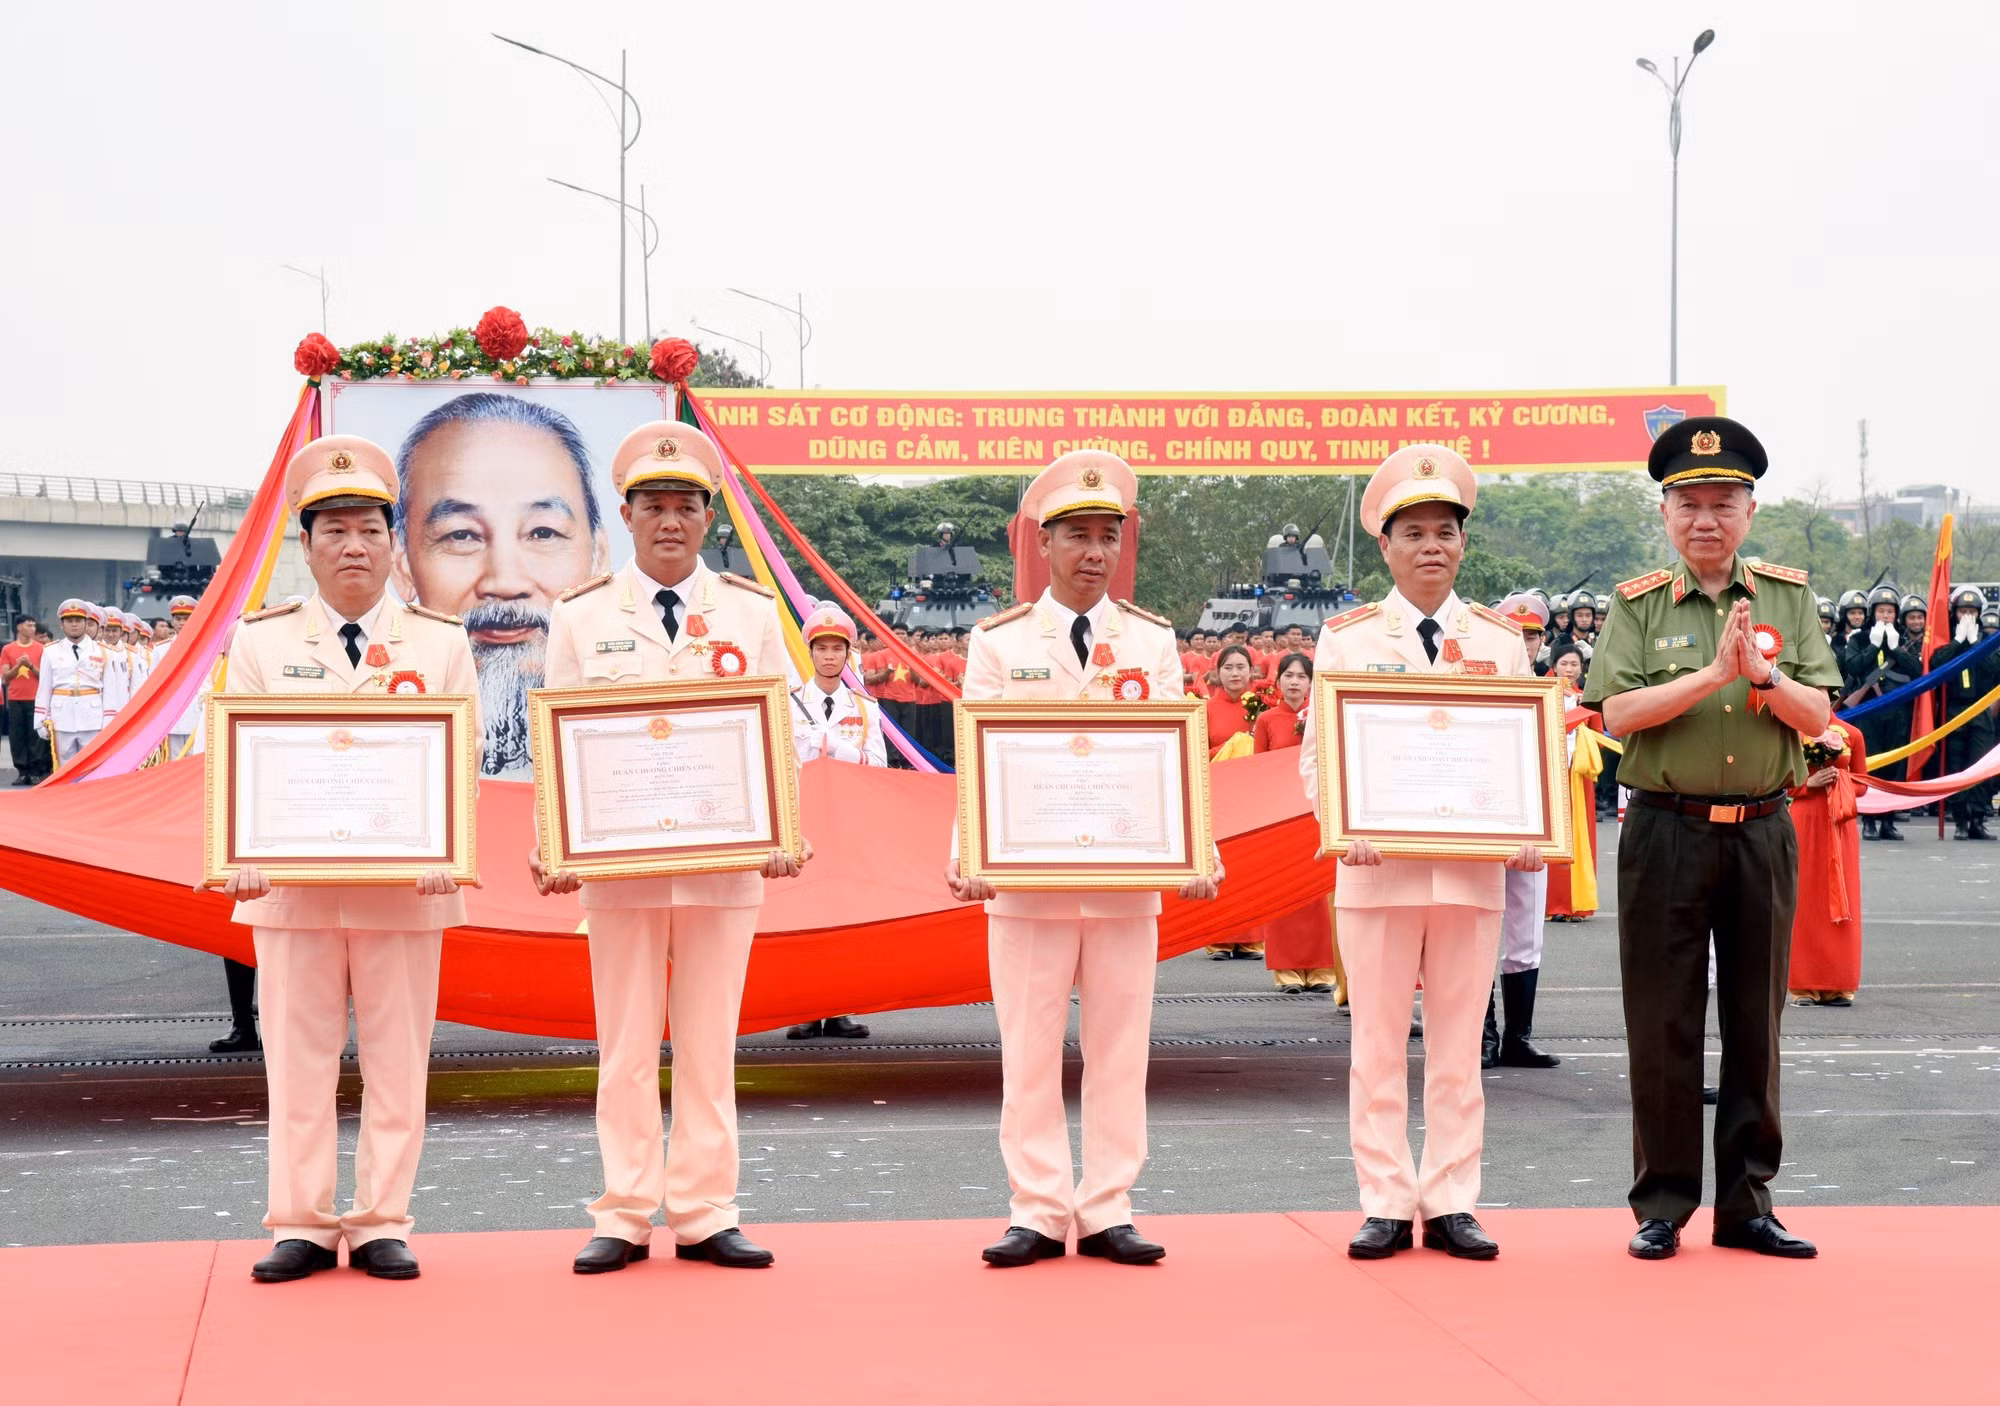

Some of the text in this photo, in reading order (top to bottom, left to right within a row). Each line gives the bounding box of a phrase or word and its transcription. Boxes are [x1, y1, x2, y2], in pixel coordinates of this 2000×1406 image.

[704, 400, 1616, 431] ẢNH SÁT CƠ ĐỘNG: TRUNG THÀNH VỚI ĐẢNG, ĐOÀN KẾT, KỶ CƯƠNG,
[808, 435, 887, 459] DŨNG
[896, 434, 968, 462] CẢM,
[977, 436, 1043, 460] KIÊN
[1166, 436, 1251, 460] CHÍNH
[1260, 440, 1318, 462] QUY,
[1326, 440, 1389, 460] TINH
